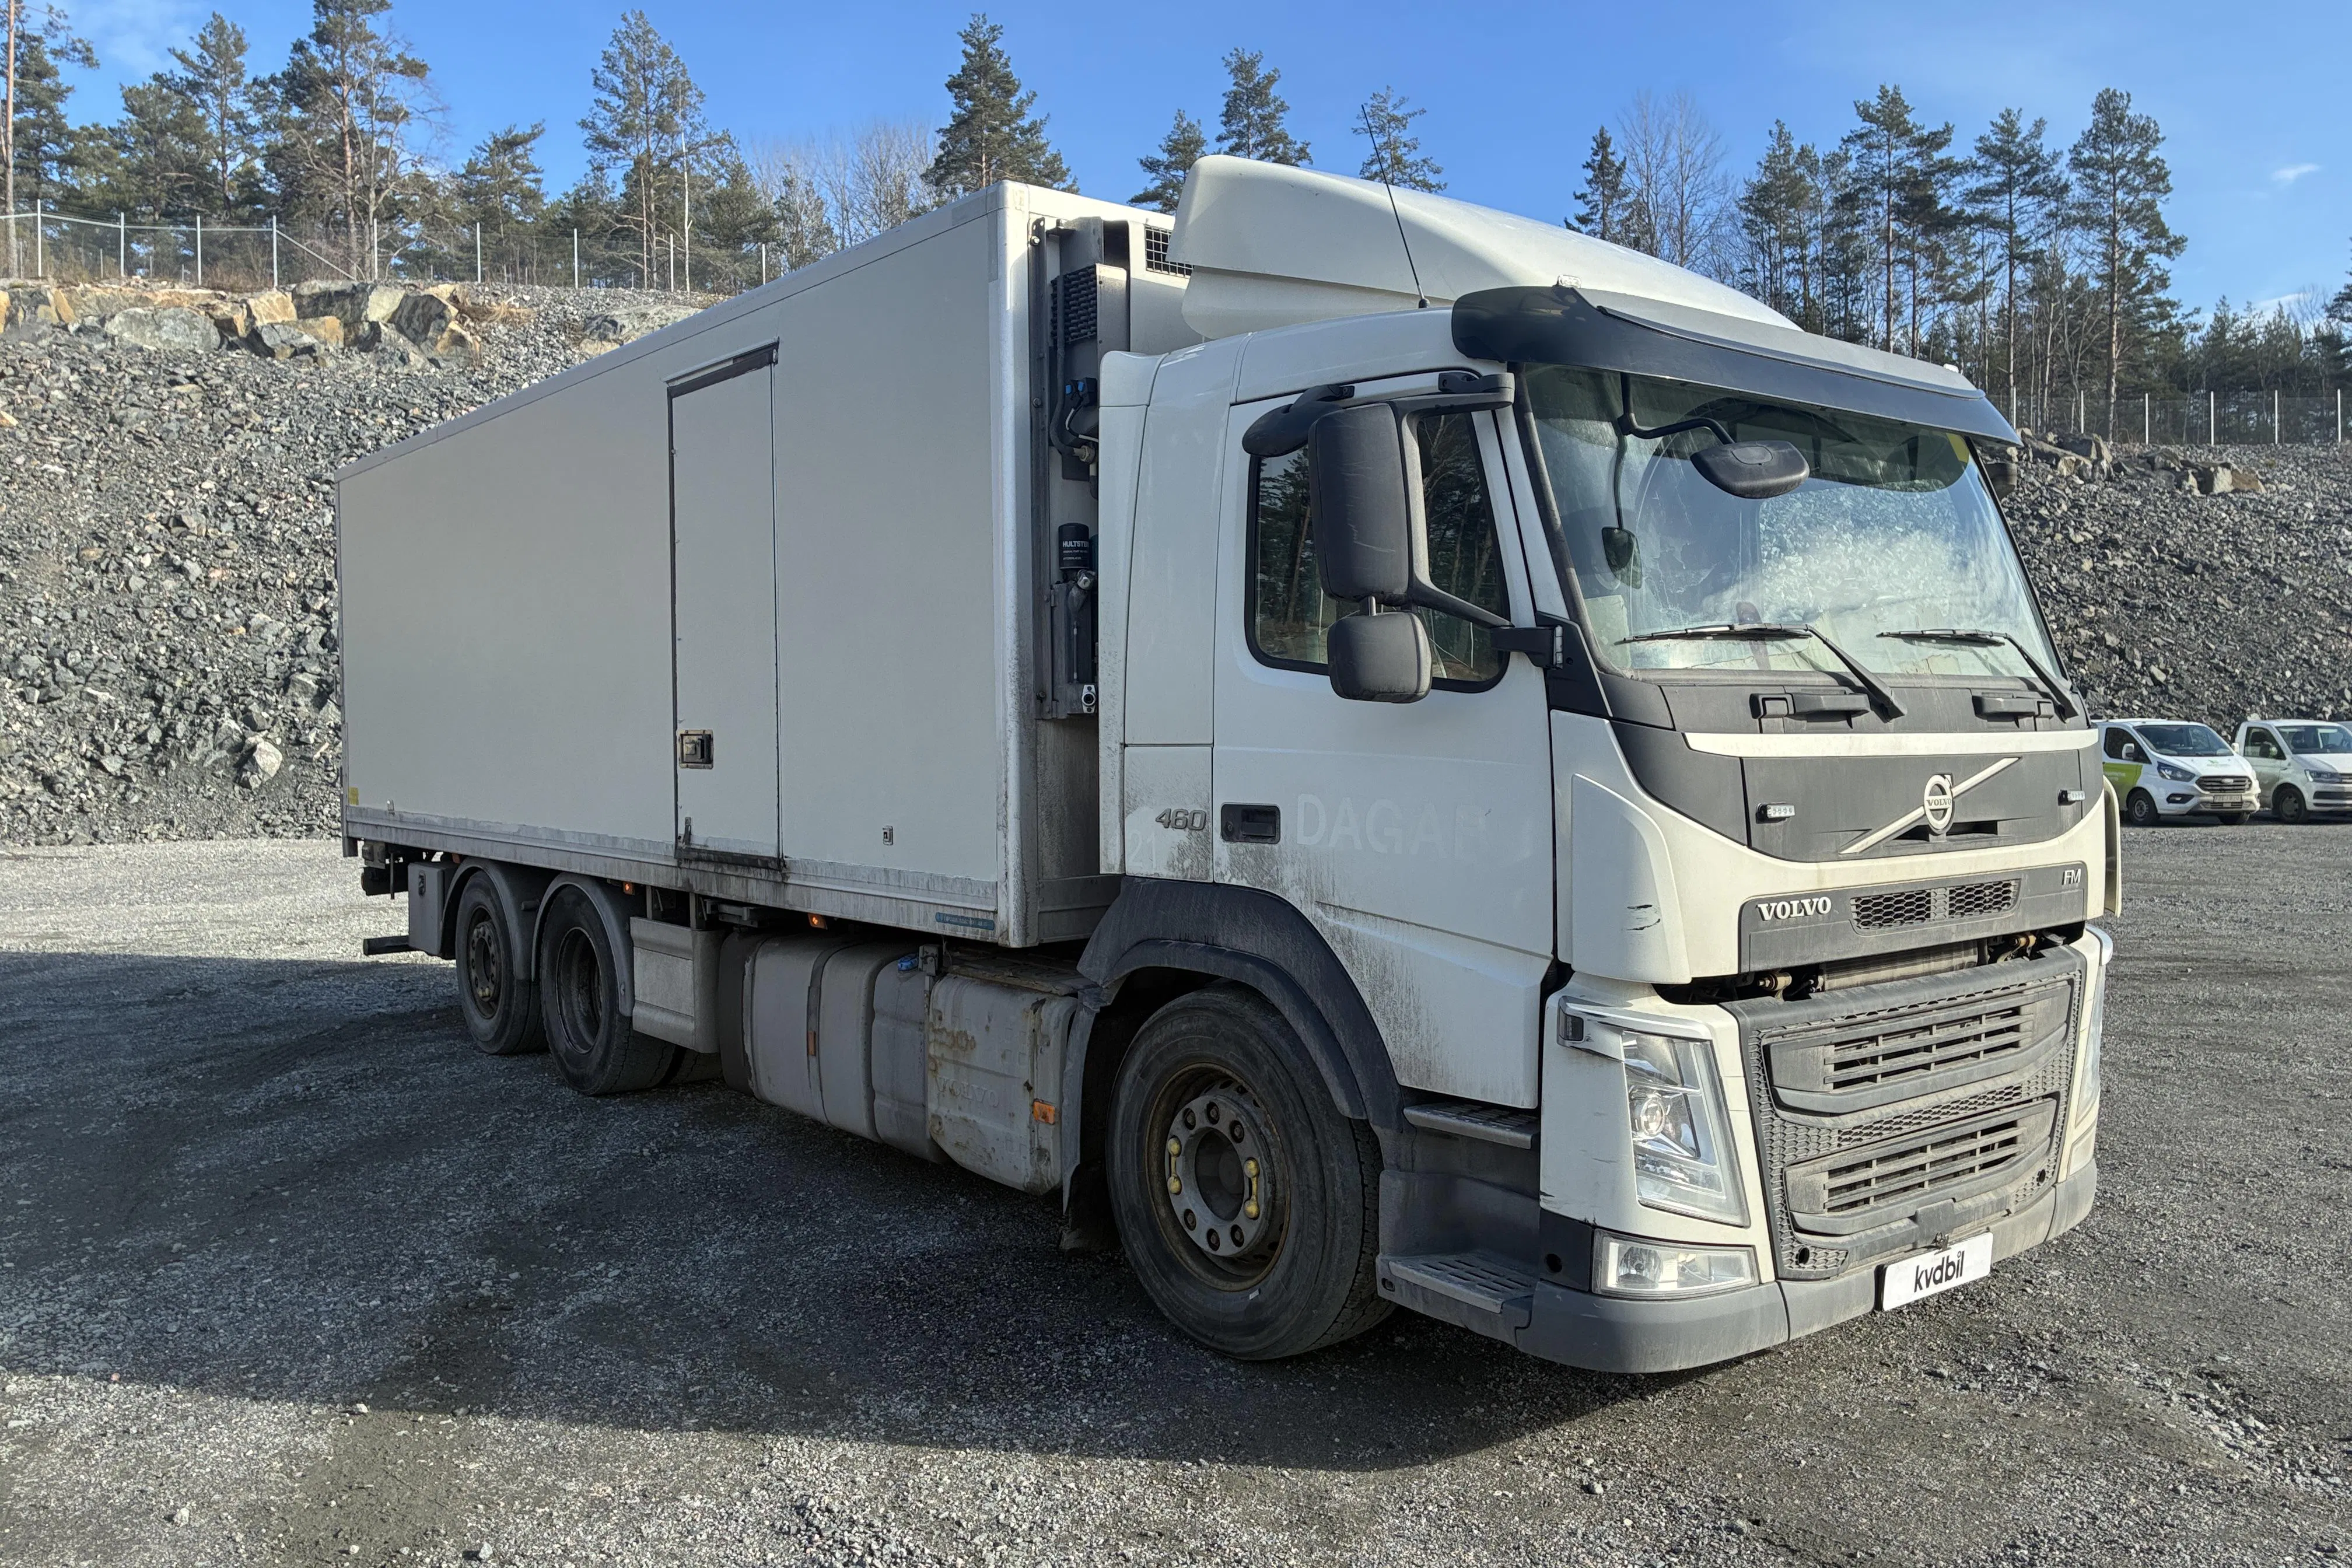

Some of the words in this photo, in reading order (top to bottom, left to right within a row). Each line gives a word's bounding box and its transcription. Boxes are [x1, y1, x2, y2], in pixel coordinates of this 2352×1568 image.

[1926, 797, 1952, 806] VOLVO
[1155, 808, 1206, 831] 460
[2063, 868, 2081, 885] FM
[1756, 897, 1832, 921] VOLVO
[935, 1076, 999, 1107] VOLVO
[1914, 1250, 1965, 1293] kvdbil
